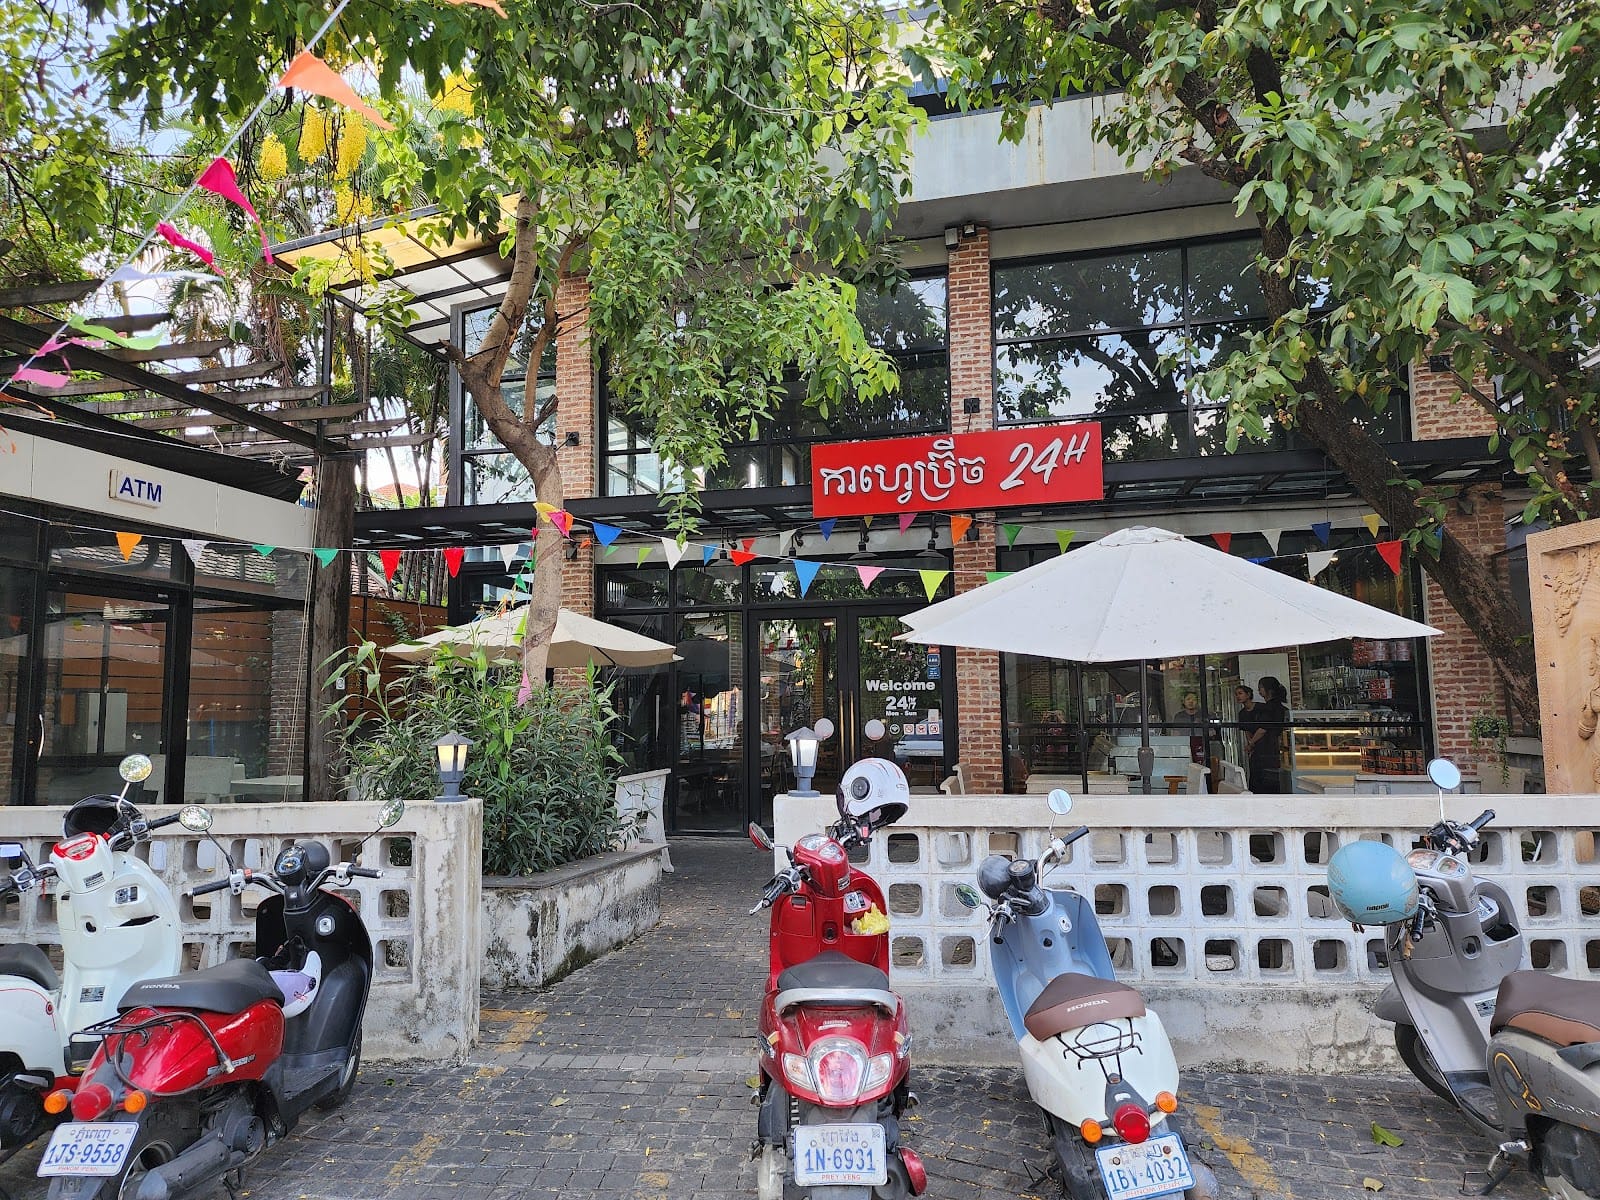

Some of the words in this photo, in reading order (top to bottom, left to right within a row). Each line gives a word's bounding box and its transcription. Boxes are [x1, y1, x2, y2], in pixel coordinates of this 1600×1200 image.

[119, 476, 162, 503] ATM
[865, 679, 936, 692] Welcome
[1066, 999, 1110, 1013] HONDA
[44, 1143, 125, 1165] 1JS-9558
[805, 1147, 876, 1172] 1N-6931
[821, 1173, 839, 1181] PREY
[842, 1173, 861, 1181] VENG
